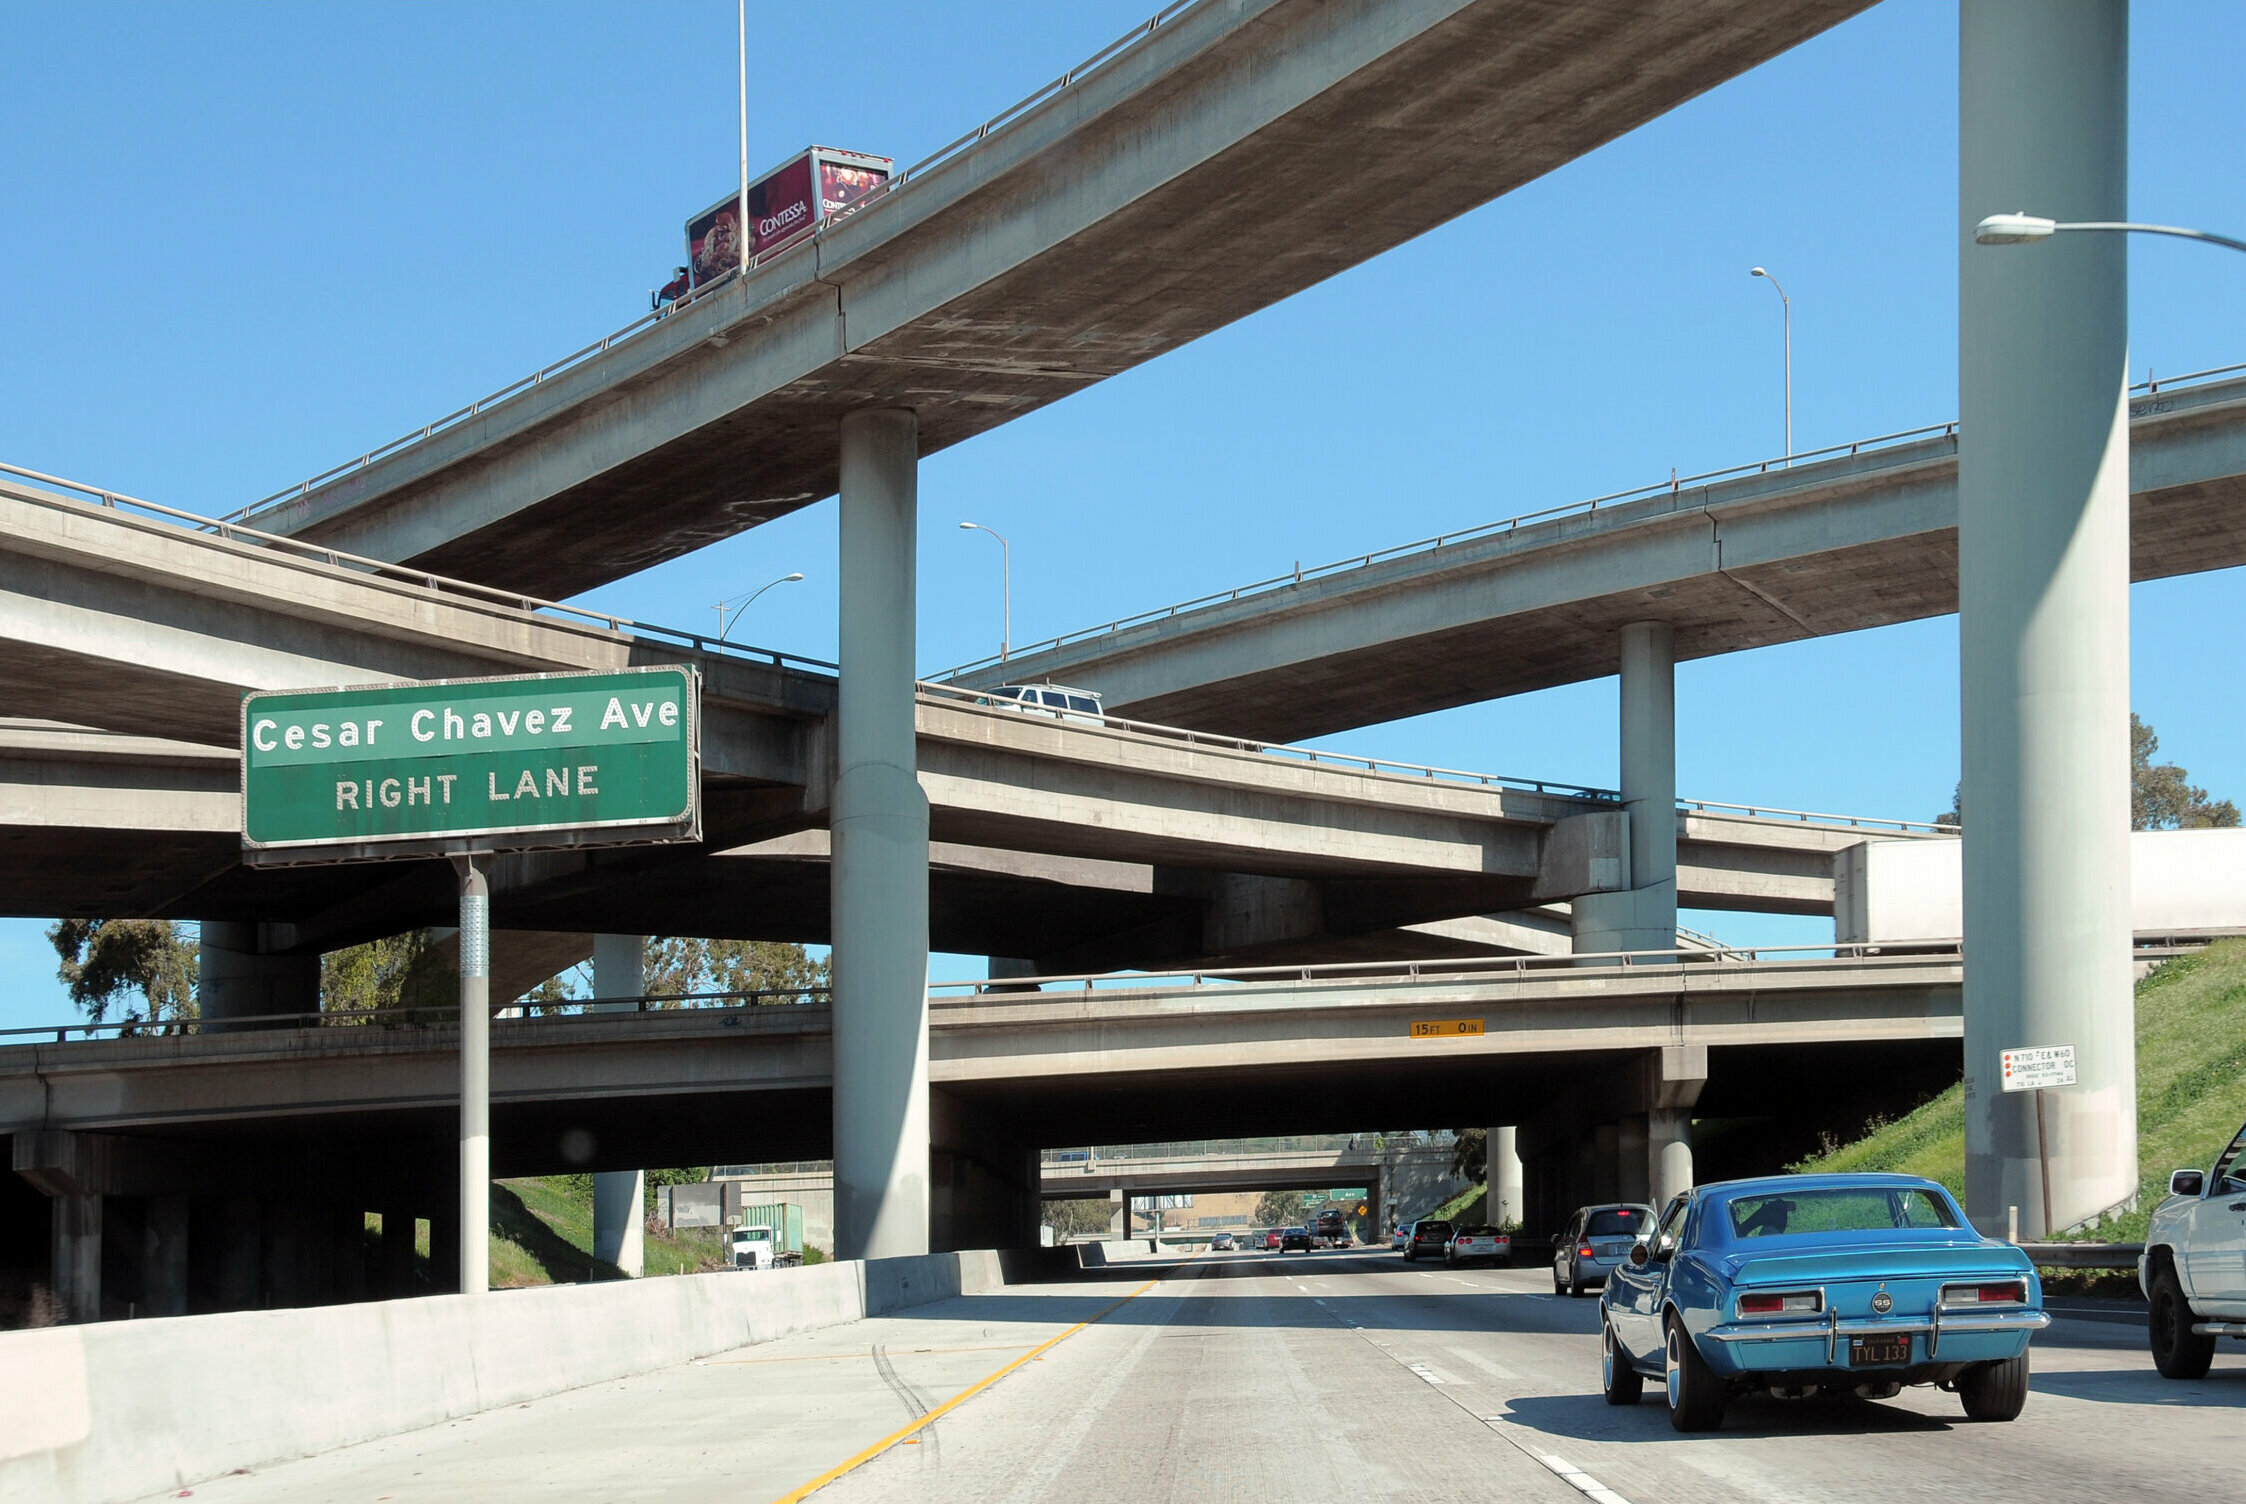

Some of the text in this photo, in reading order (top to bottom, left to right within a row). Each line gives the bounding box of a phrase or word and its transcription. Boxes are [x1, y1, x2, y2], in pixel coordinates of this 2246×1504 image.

[759, 200, 807, 236] CONTESSA
[253, 697, 679, 753] Cesar Chavez Ave
[335, 765, 599, 811] RIGHT LANE
[2012, 1061, 2056, 1073] CONNECTOR
[1853, 1345, 1908, 1362] TYL 133
